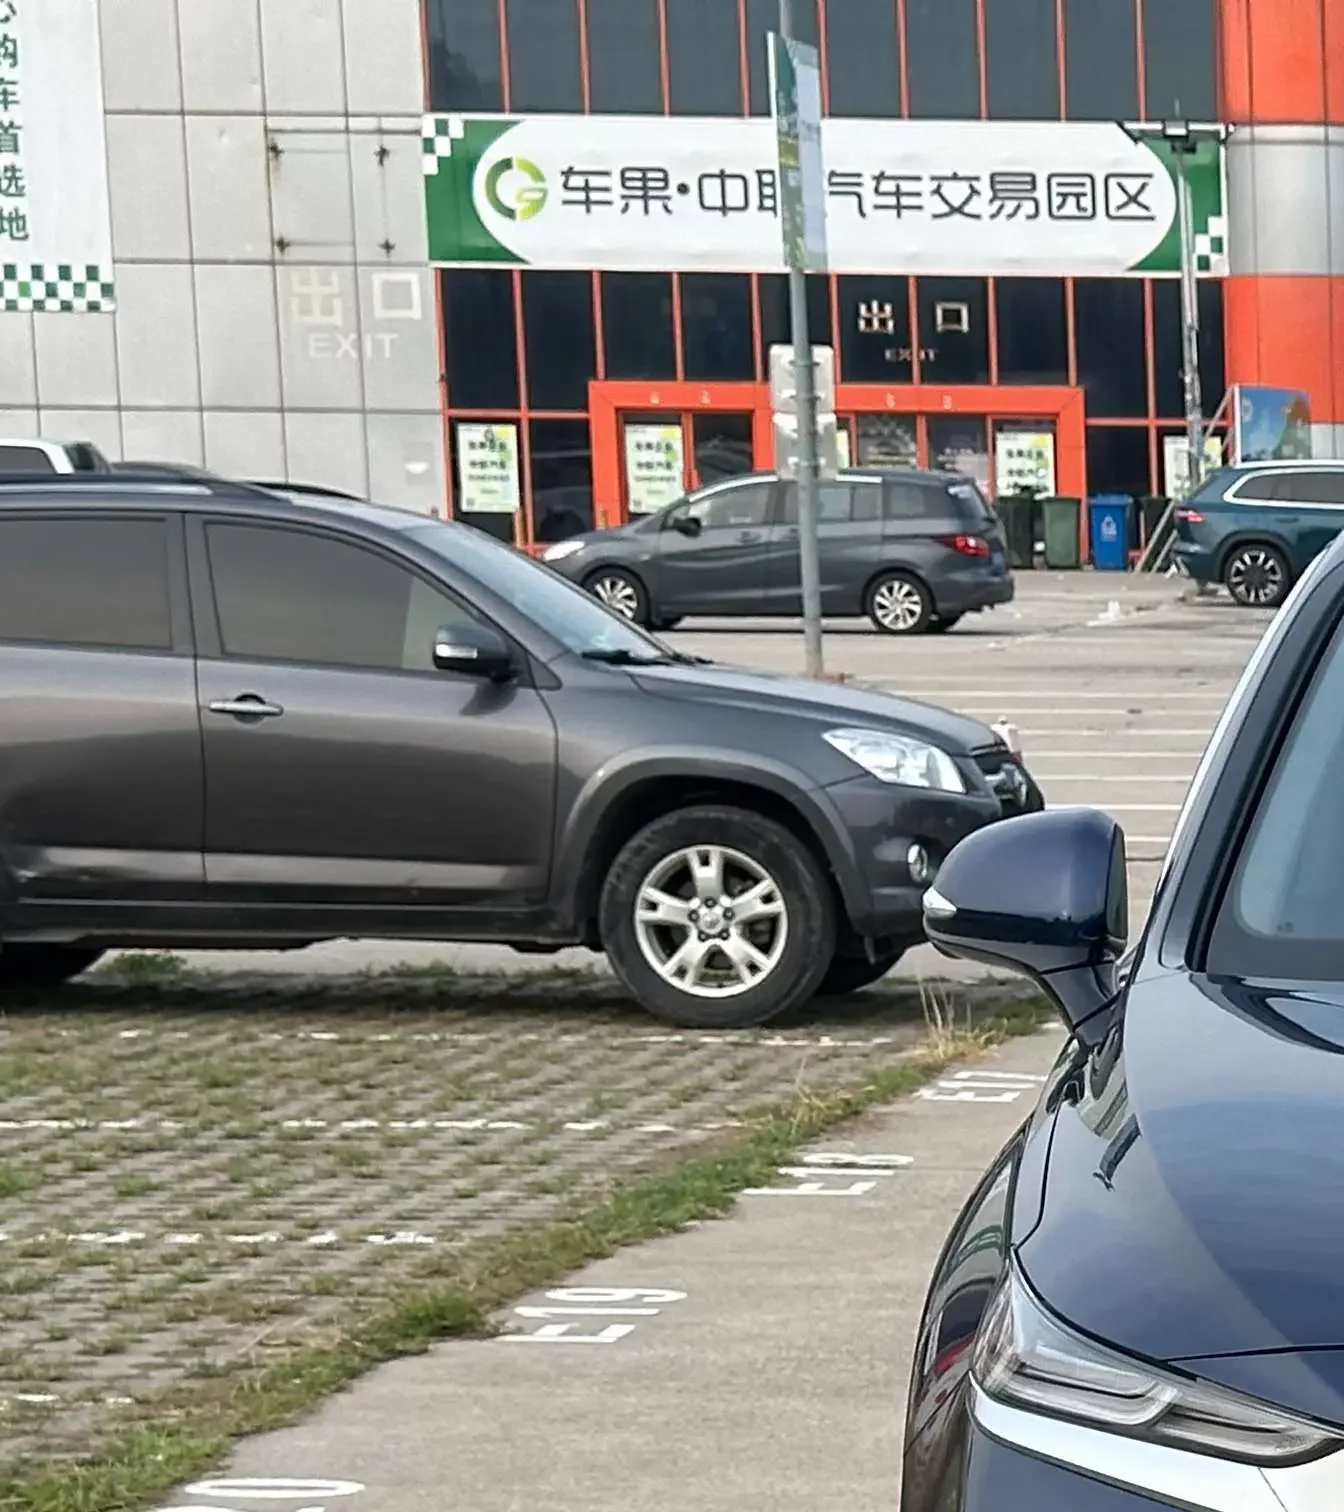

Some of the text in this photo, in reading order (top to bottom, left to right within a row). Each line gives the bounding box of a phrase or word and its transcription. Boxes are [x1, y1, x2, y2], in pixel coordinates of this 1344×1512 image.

[289, 268, 422, 327] 出口
[858, 299, 970, 334] 出口
[308, 332, 399, 359] EXIT
[494, 1287, 688, 1342] E19
